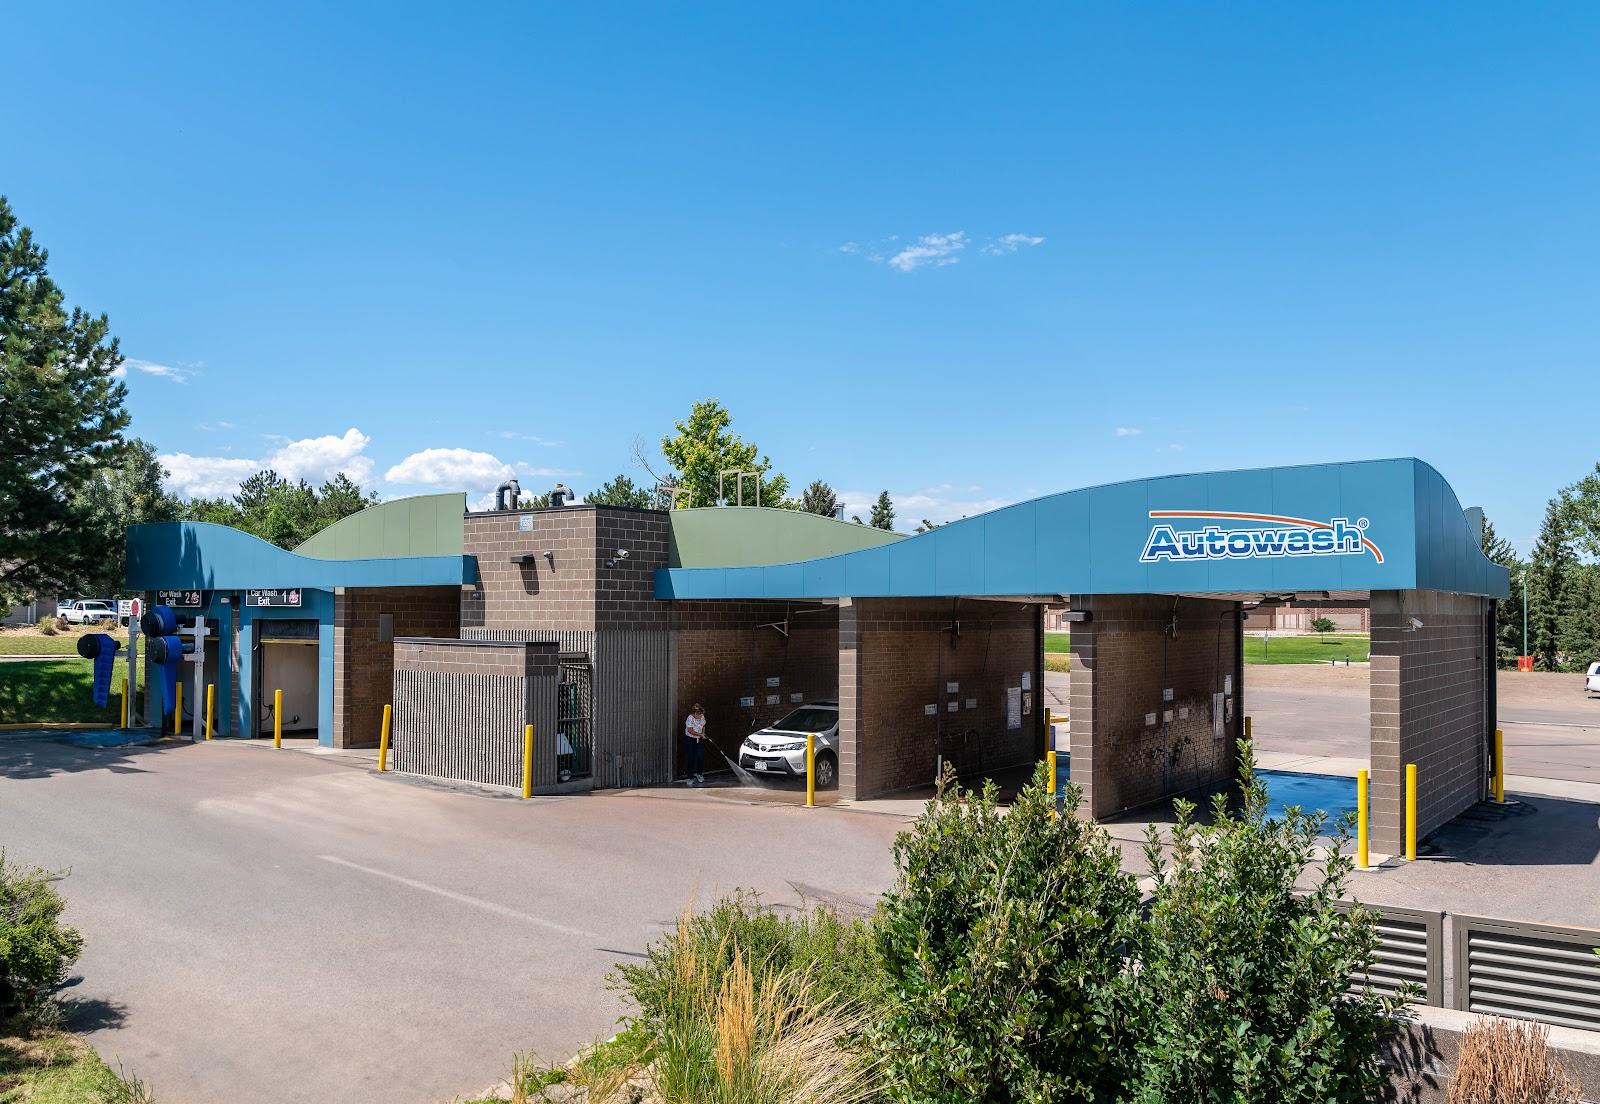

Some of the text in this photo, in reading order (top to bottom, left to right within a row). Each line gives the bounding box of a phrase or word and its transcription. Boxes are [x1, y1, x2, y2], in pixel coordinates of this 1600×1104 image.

[1141, 518, 1363, 561] Autowash
[159, 590, 182, 598] Car Wash
[185, 592, 190, 604] 2
[282, 590, 287, 603] 1
[165, 598, 176, 606] Exit
[257, 597, 270, 605] Exit
